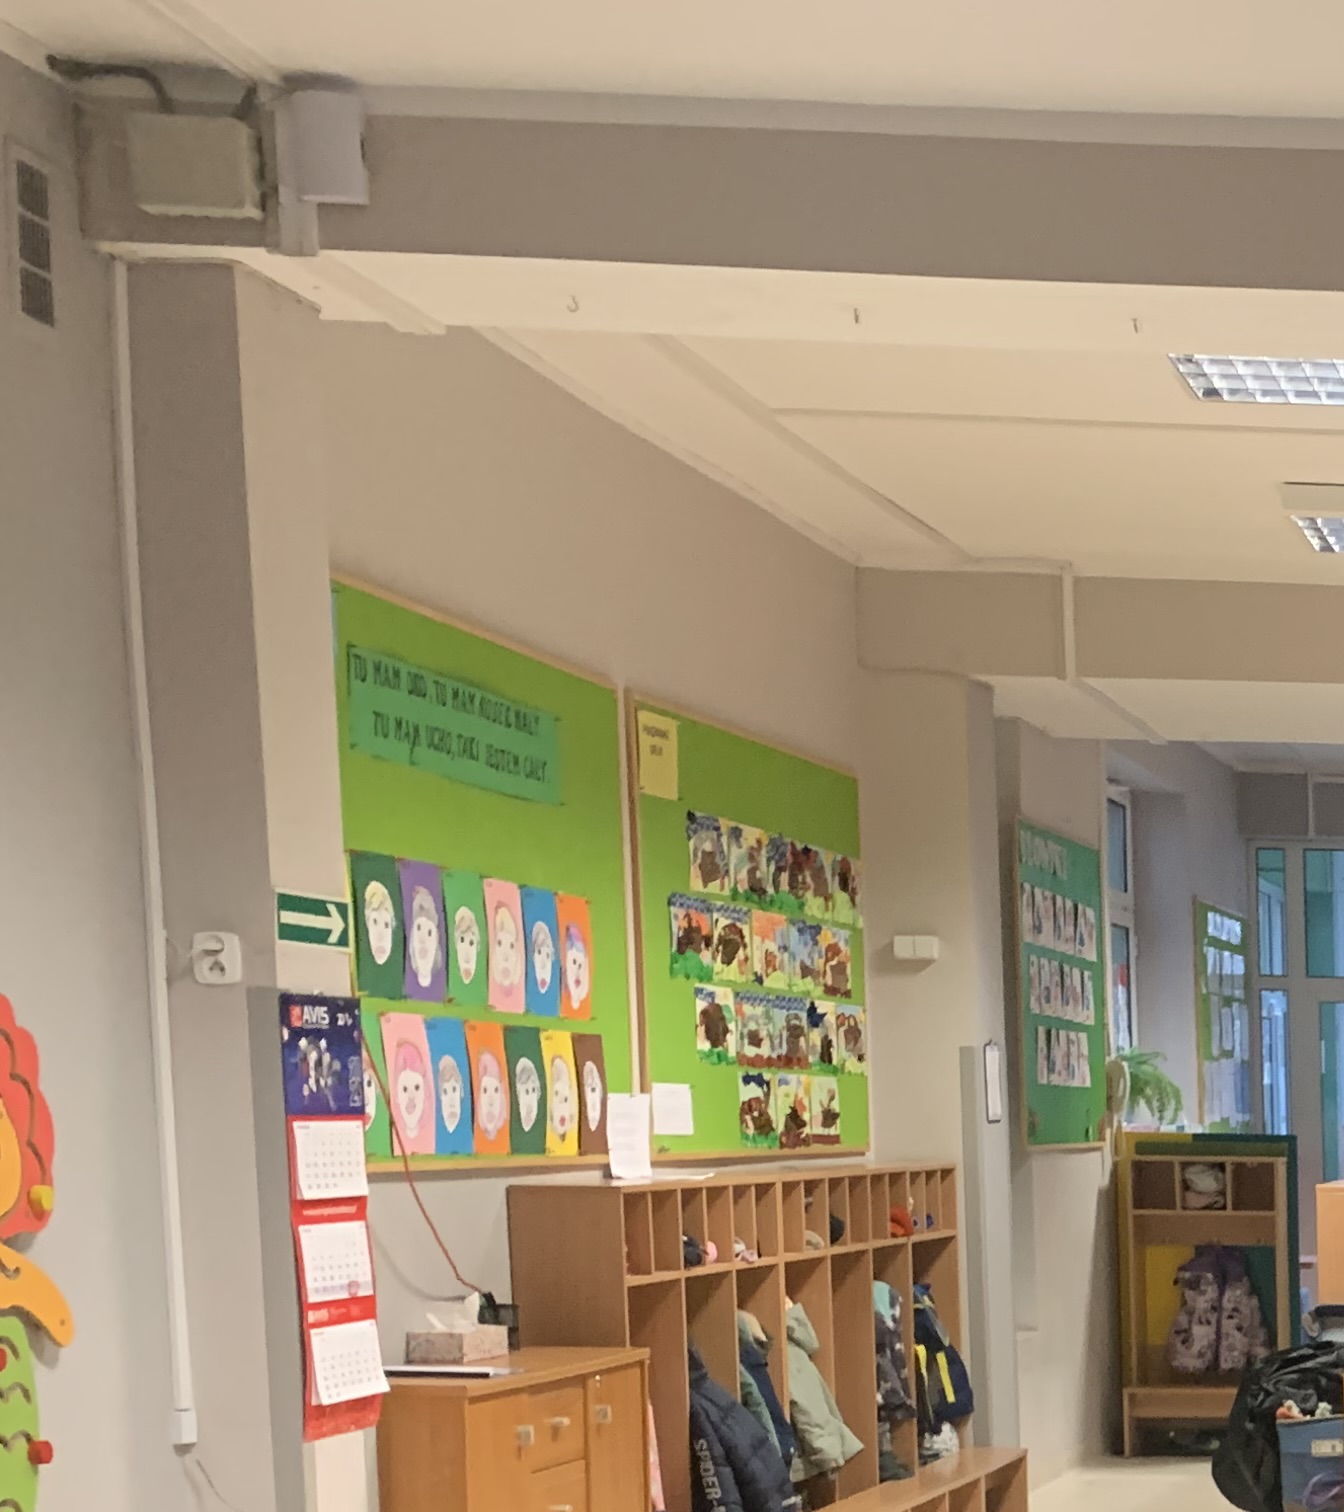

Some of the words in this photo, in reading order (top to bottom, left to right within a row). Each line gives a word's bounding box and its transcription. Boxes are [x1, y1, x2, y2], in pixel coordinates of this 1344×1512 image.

[352, 653, 367, 683] TU
[373, 659, 401, 691] MAM
[433, 679, 447, 708] TU
[451, 687, 476, 716] MAM
[372, 710, 390, 739] TU
